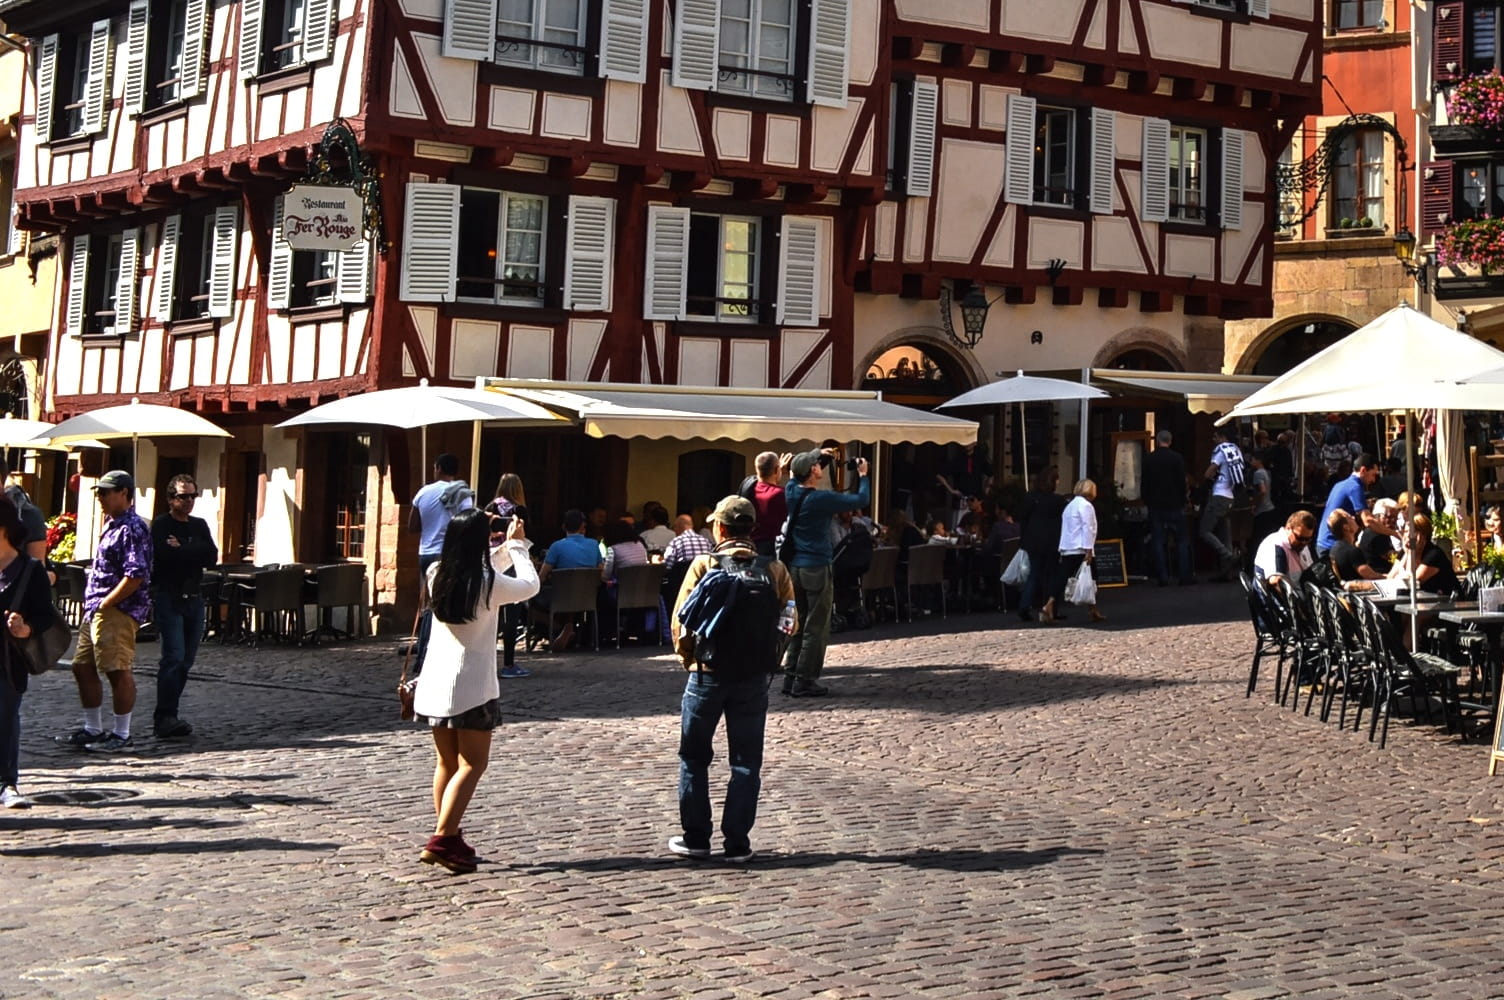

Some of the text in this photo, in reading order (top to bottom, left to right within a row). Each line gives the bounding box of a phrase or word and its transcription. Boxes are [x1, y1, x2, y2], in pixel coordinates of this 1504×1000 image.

[301, 197, 346, 209] Restaurant
[286, 215, 356, 239] Fer Rouge
